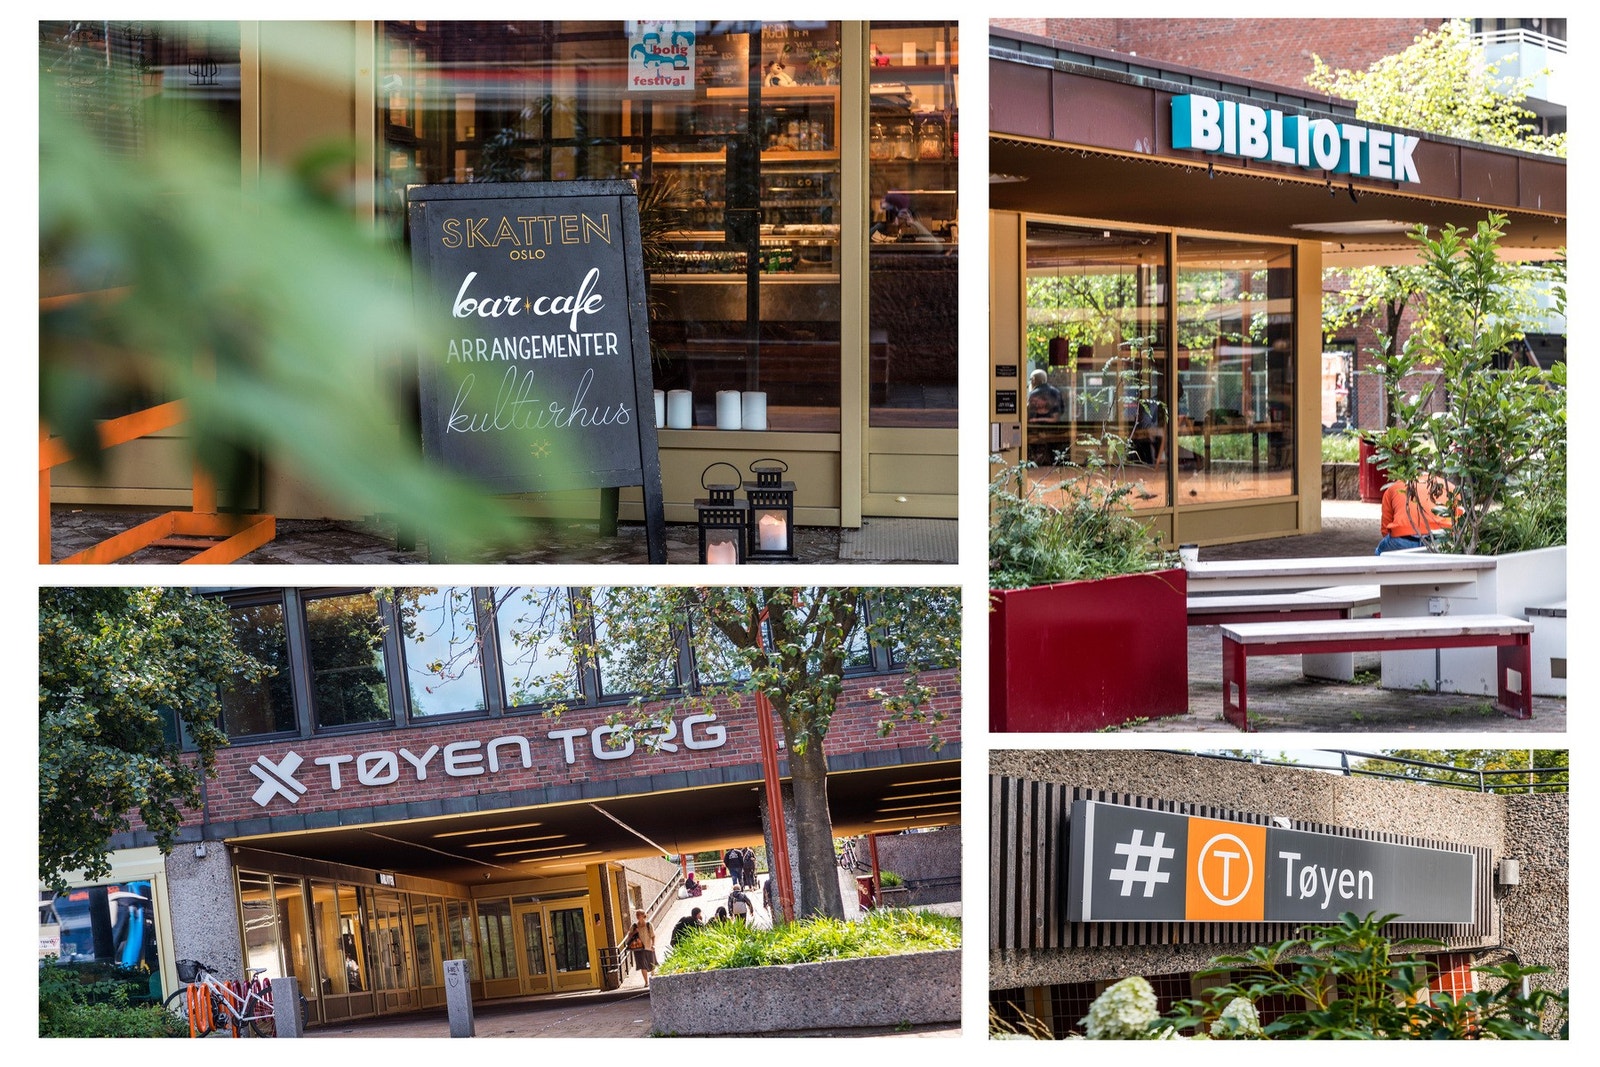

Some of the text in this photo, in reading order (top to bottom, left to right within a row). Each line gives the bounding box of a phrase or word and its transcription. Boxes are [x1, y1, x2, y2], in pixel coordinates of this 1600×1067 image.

[653, 44, 688, 57] bolig
[633, 74, 686, 86] festival
[1190, 94, 1421, 184] BIBLIOTEK
[441, 213, 612, 249] SKATTEN
[509, 248, 546, 261] OSLO
[452, 267, 606, 332] bar cafe
[446, 331, 619, 364] ARRANGEMENTER
[446, 365, 632, 434] kulturhus
[314, 713, 728, 791] TØYEN TORG
[1278, 851, 1374, 909] Tøyen
